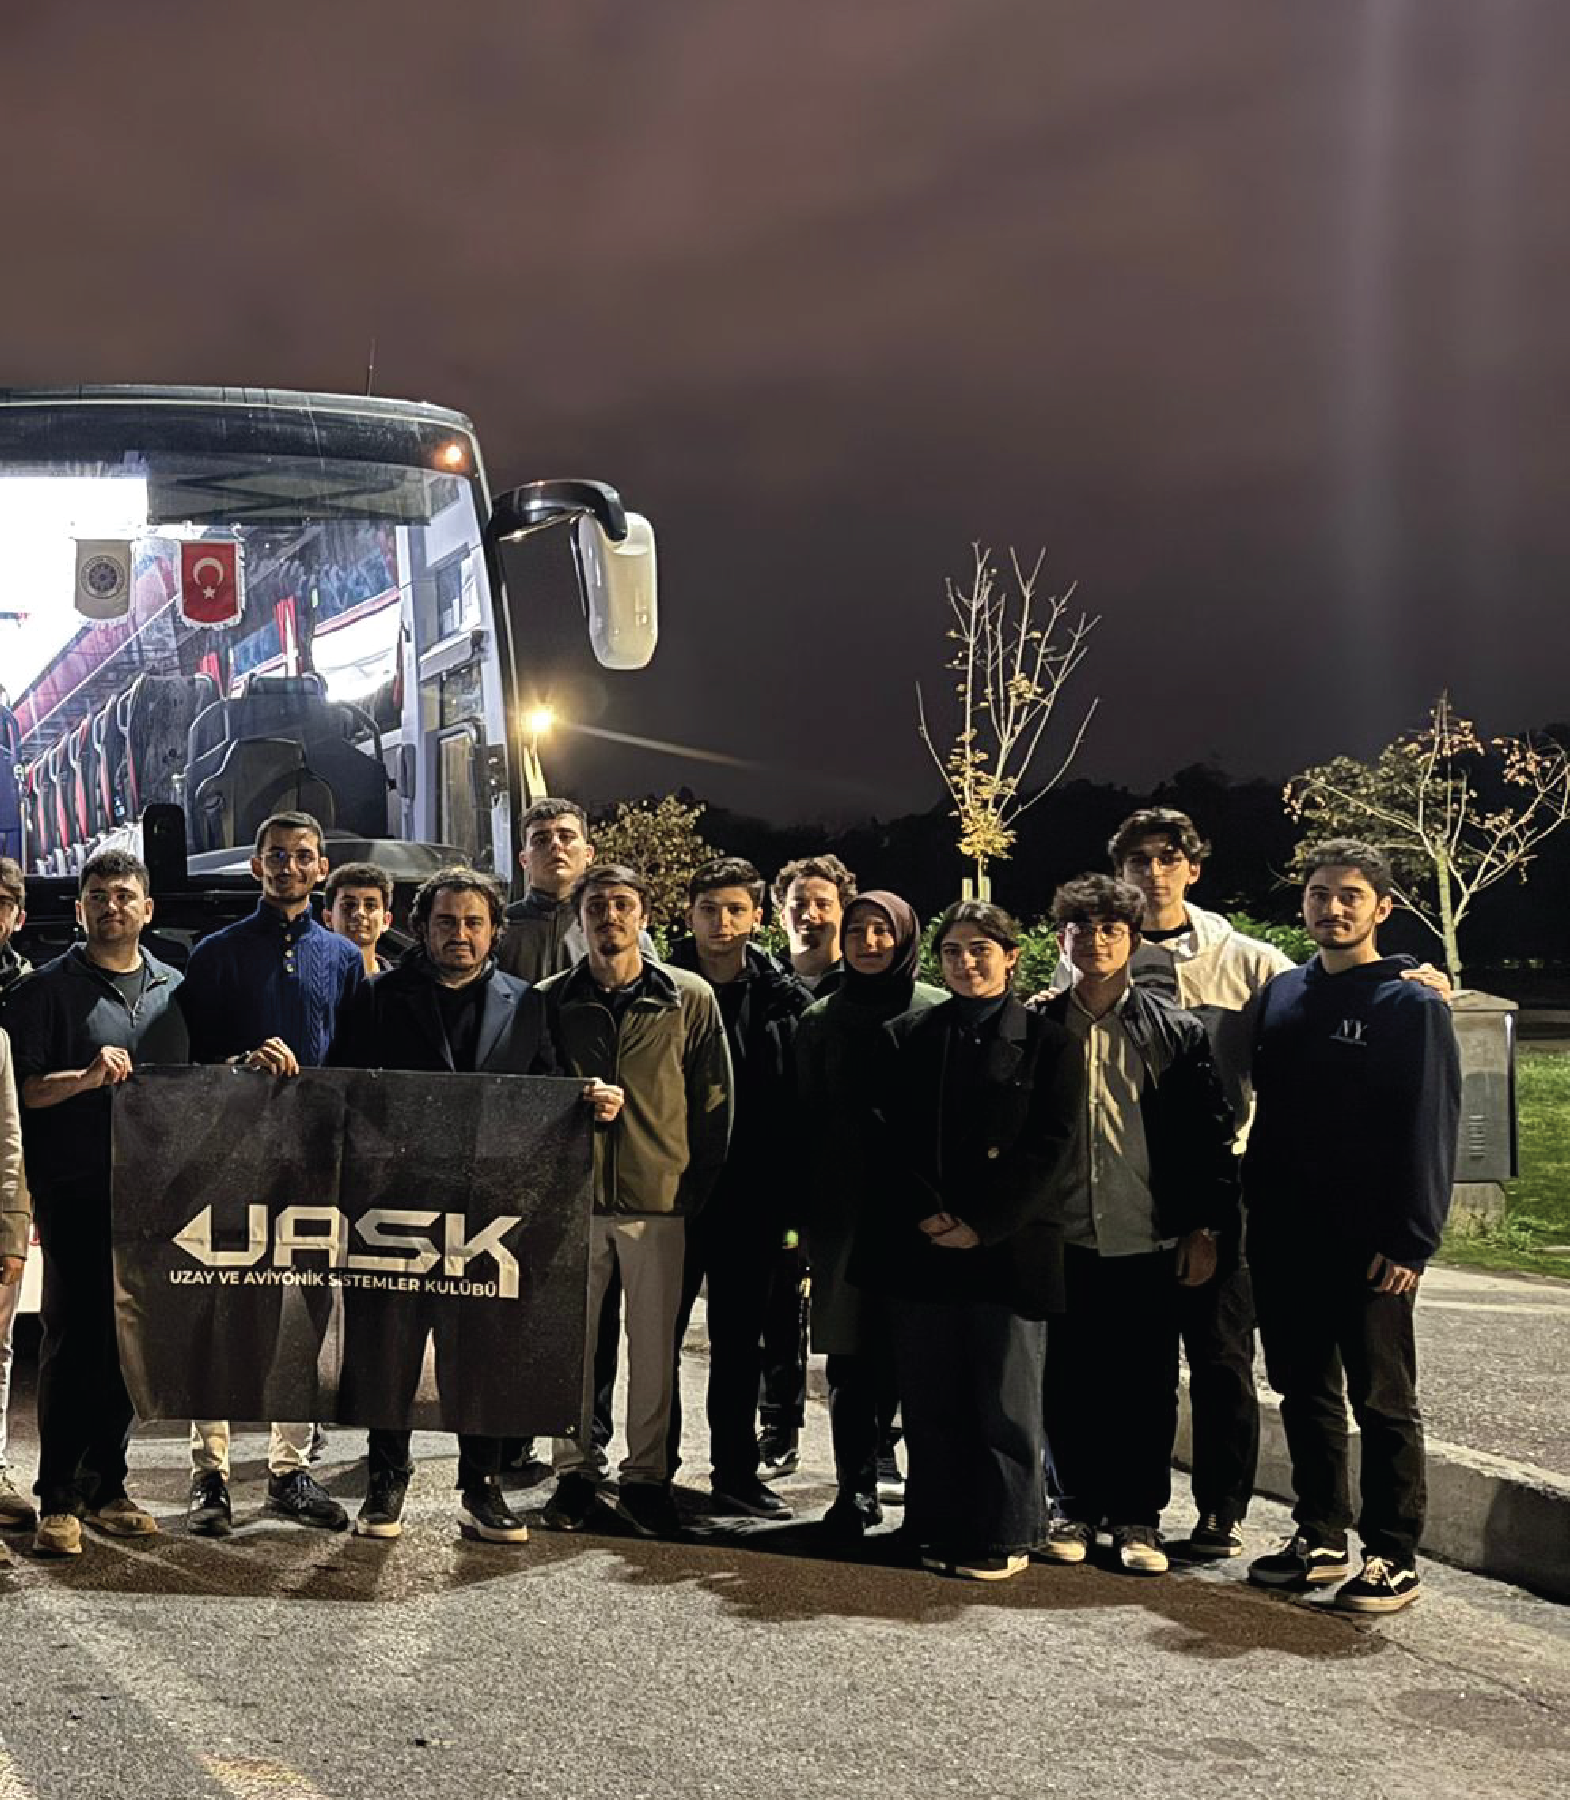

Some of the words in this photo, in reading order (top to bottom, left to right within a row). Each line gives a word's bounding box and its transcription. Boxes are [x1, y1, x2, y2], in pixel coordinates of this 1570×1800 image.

[171, 1204, 522, 1298] UASK
[170, 1269, 215, 1285] UZAY
[218, 1270, 240, 1285] VE
[328, 1271, 420, 1290] SİSTEMLER
[425, 1279, 497, 1298] KULÜBÜ
